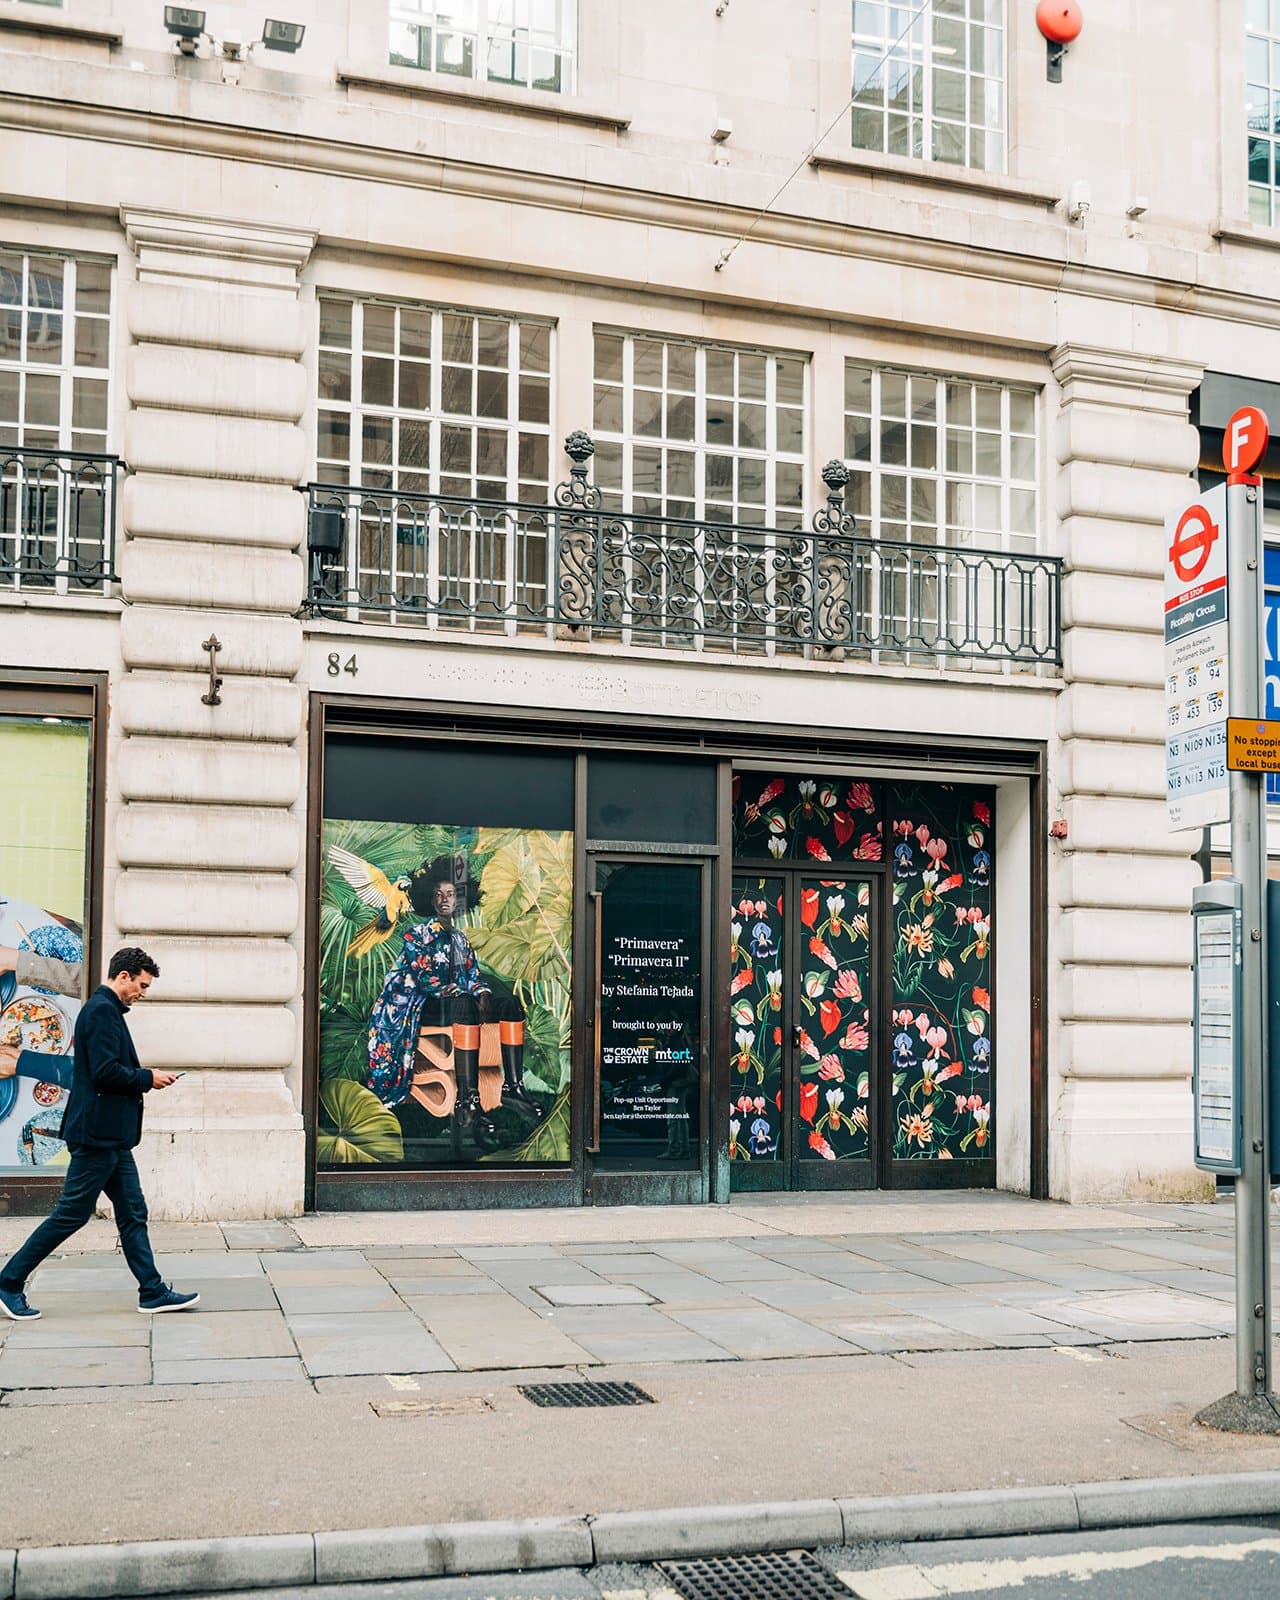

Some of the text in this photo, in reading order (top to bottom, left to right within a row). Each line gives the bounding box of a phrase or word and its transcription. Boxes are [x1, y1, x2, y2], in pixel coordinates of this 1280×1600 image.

[1231, 415, 1252, 469] F
[1179, 586, 1204, 603] BUS STOP
[1170, 604, 1216, 629] Piccadilly Circus
[327, 651, 359, 678] 84
[1187, 674, 1197, 687] 88
[1209, 668, 1220, 680] 94
[1168, 712, 1180, 727] 159
[1187, 705, 1200, 719] 453
[1208, 699, 1223, 714] 139
[1169, 732, 1227, 759] N3 N109 N136
[1234, 735, 1248, 745] No
[1246, 749, 1277, 759] except
[1235, 757, 1258, 768] local
[1168, 765, 1225, 791] N18 N113 N15
[614, 936, 684, 950] “Primavera”
[608, 954, 673, 967] “Primavera
[601, 983, 694, 998] by Stefania Tejada
[612, 1019, 683, 1032] brought to you by
[614, 1047, 649, 1056] CROWN
[614, 1055, 649, 1064] ESTATE
[613, 1096, 634, 1104] Pop-up
[646, 1096, 679, 1104] Opportunity
[644, 1104, 661, 1112] Taylor
